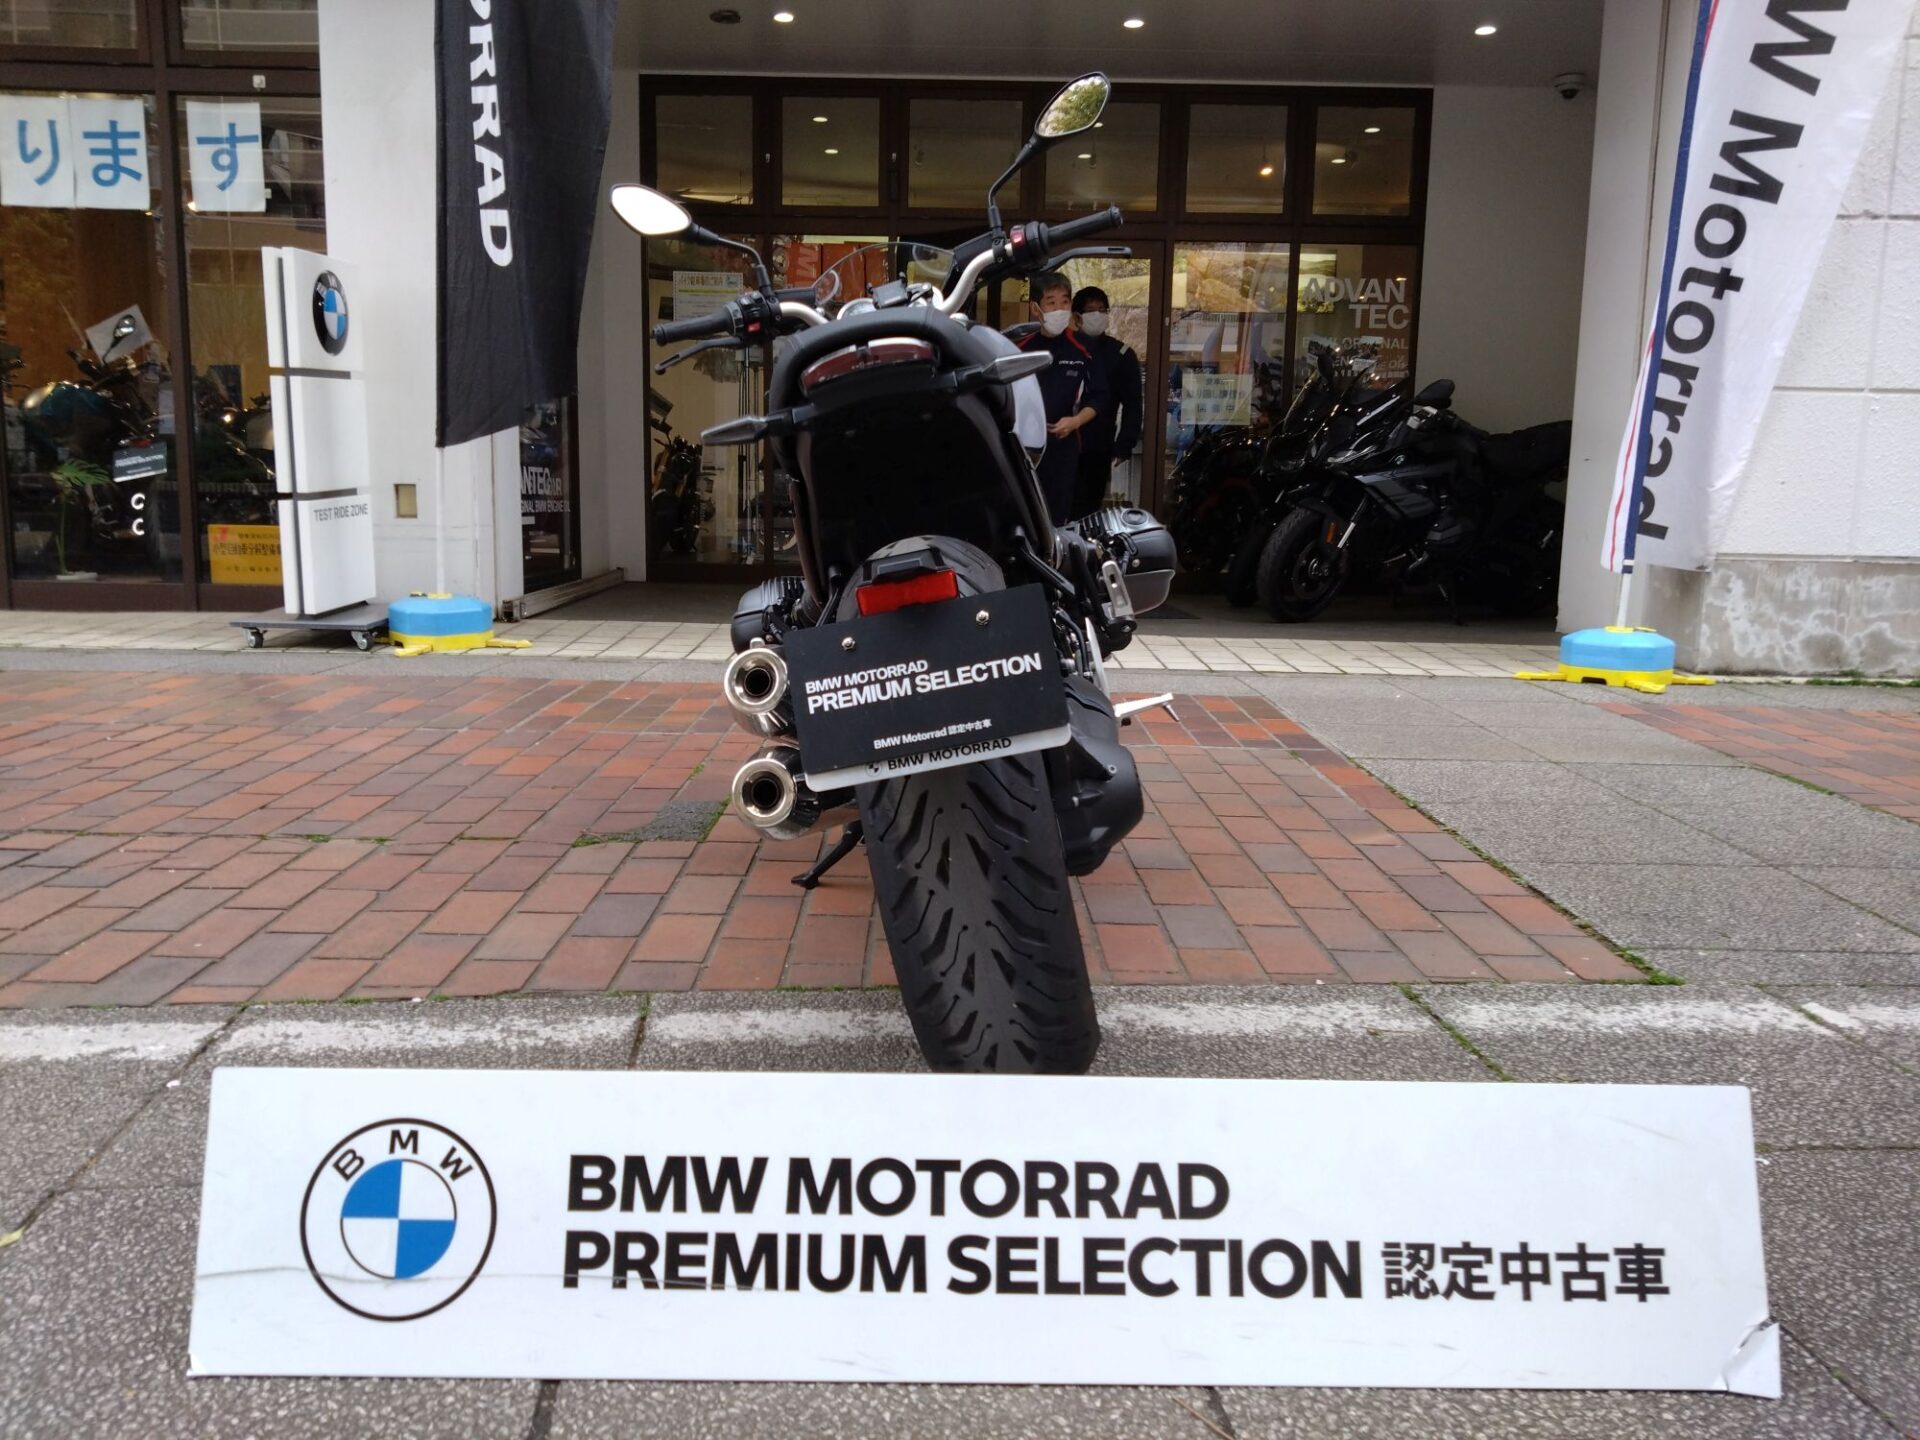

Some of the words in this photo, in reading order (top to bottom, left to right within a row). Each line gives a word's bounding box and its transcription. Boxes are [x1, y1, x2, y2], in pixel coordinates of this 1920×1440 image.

[469, 0, 513, 267] RRAD
[1302, 278, 1406, 303] ADVAN
[1348, 303, 1410, 330] TEC
[1634, 109, 1805, 540] Motorrad
[313, 507, 333, 521] TEST
[333, 505, 350, 519] RIDE
[350, 503, 369, 517] ZONE
[805, 676, 842, 694] BMW
[844, 659, 929, 687] MOTORRAD
[807, 677, 912, 715] PREMIUM
[915, 652, 1042, 694] SELECTION
[873, 736, 901, 750] BMW
[902, 727, 948, 744] Motorrad
[888, 754, 924, 771] BMW
[928, 737, 1012, 763] MOTORRAD
[332, 1129, 473, 1181] BMW
[567, 1154, 769, 1213] BMW
[786, 1157, 1230, 1220] MOTORRAD
[563, 1230, 927, 1293] PREMIUM
[947, 1233, 1362, 1299] SELECTION
[1382, 1240, 1670, 1303] 認定中古車
